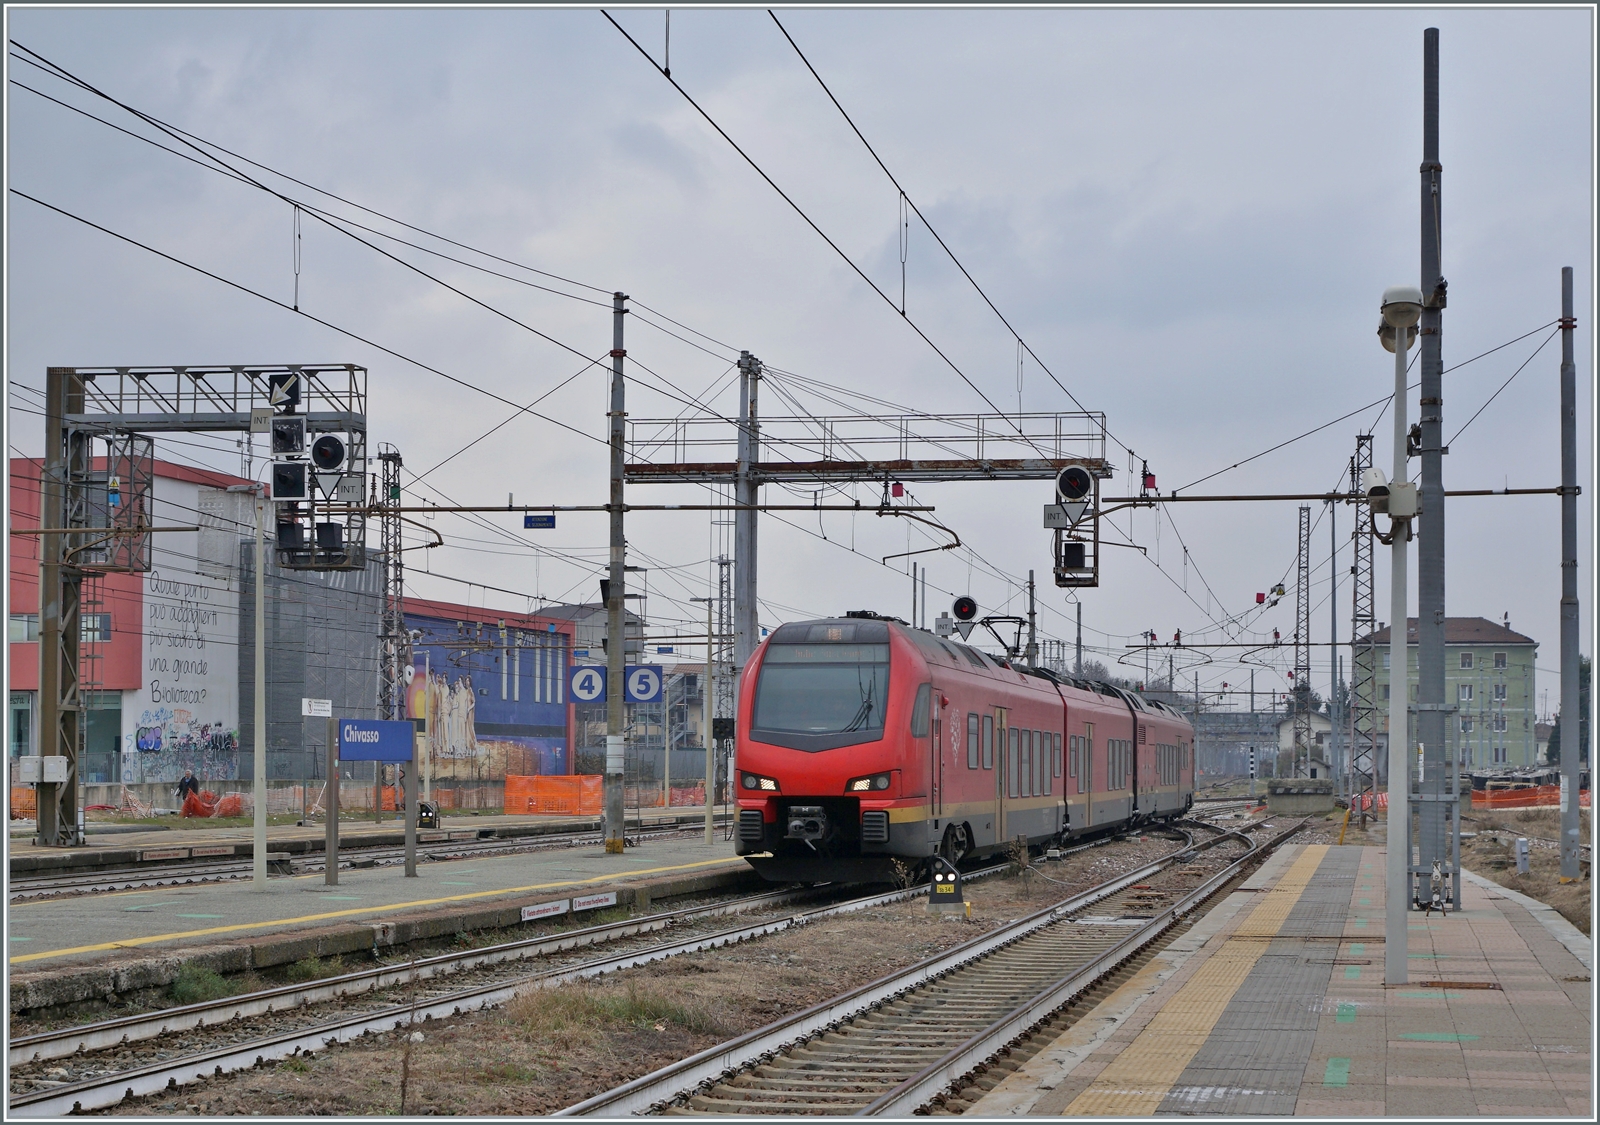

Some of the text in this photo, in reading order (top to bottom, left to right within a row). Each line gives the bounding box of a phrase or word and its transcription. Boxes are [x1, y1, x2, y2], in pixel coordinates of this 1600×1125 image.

[253, 416, 270, 425] INT.
[340, 485, 359, 494] INT.
[1047, 512, 1064, 521] INT.
[149, 570, 180, 596] Quale
[149, 604, 167, 626] può
[149, 629, 164, 652] più
[149, 657, 208, 682] una grande
[150, 679, 208, 704] Biblioteca?
[578, 674, 595, 695] 4
[636, 674, 652, 695] 5
[344, 724, 379, 743] Chivasso
